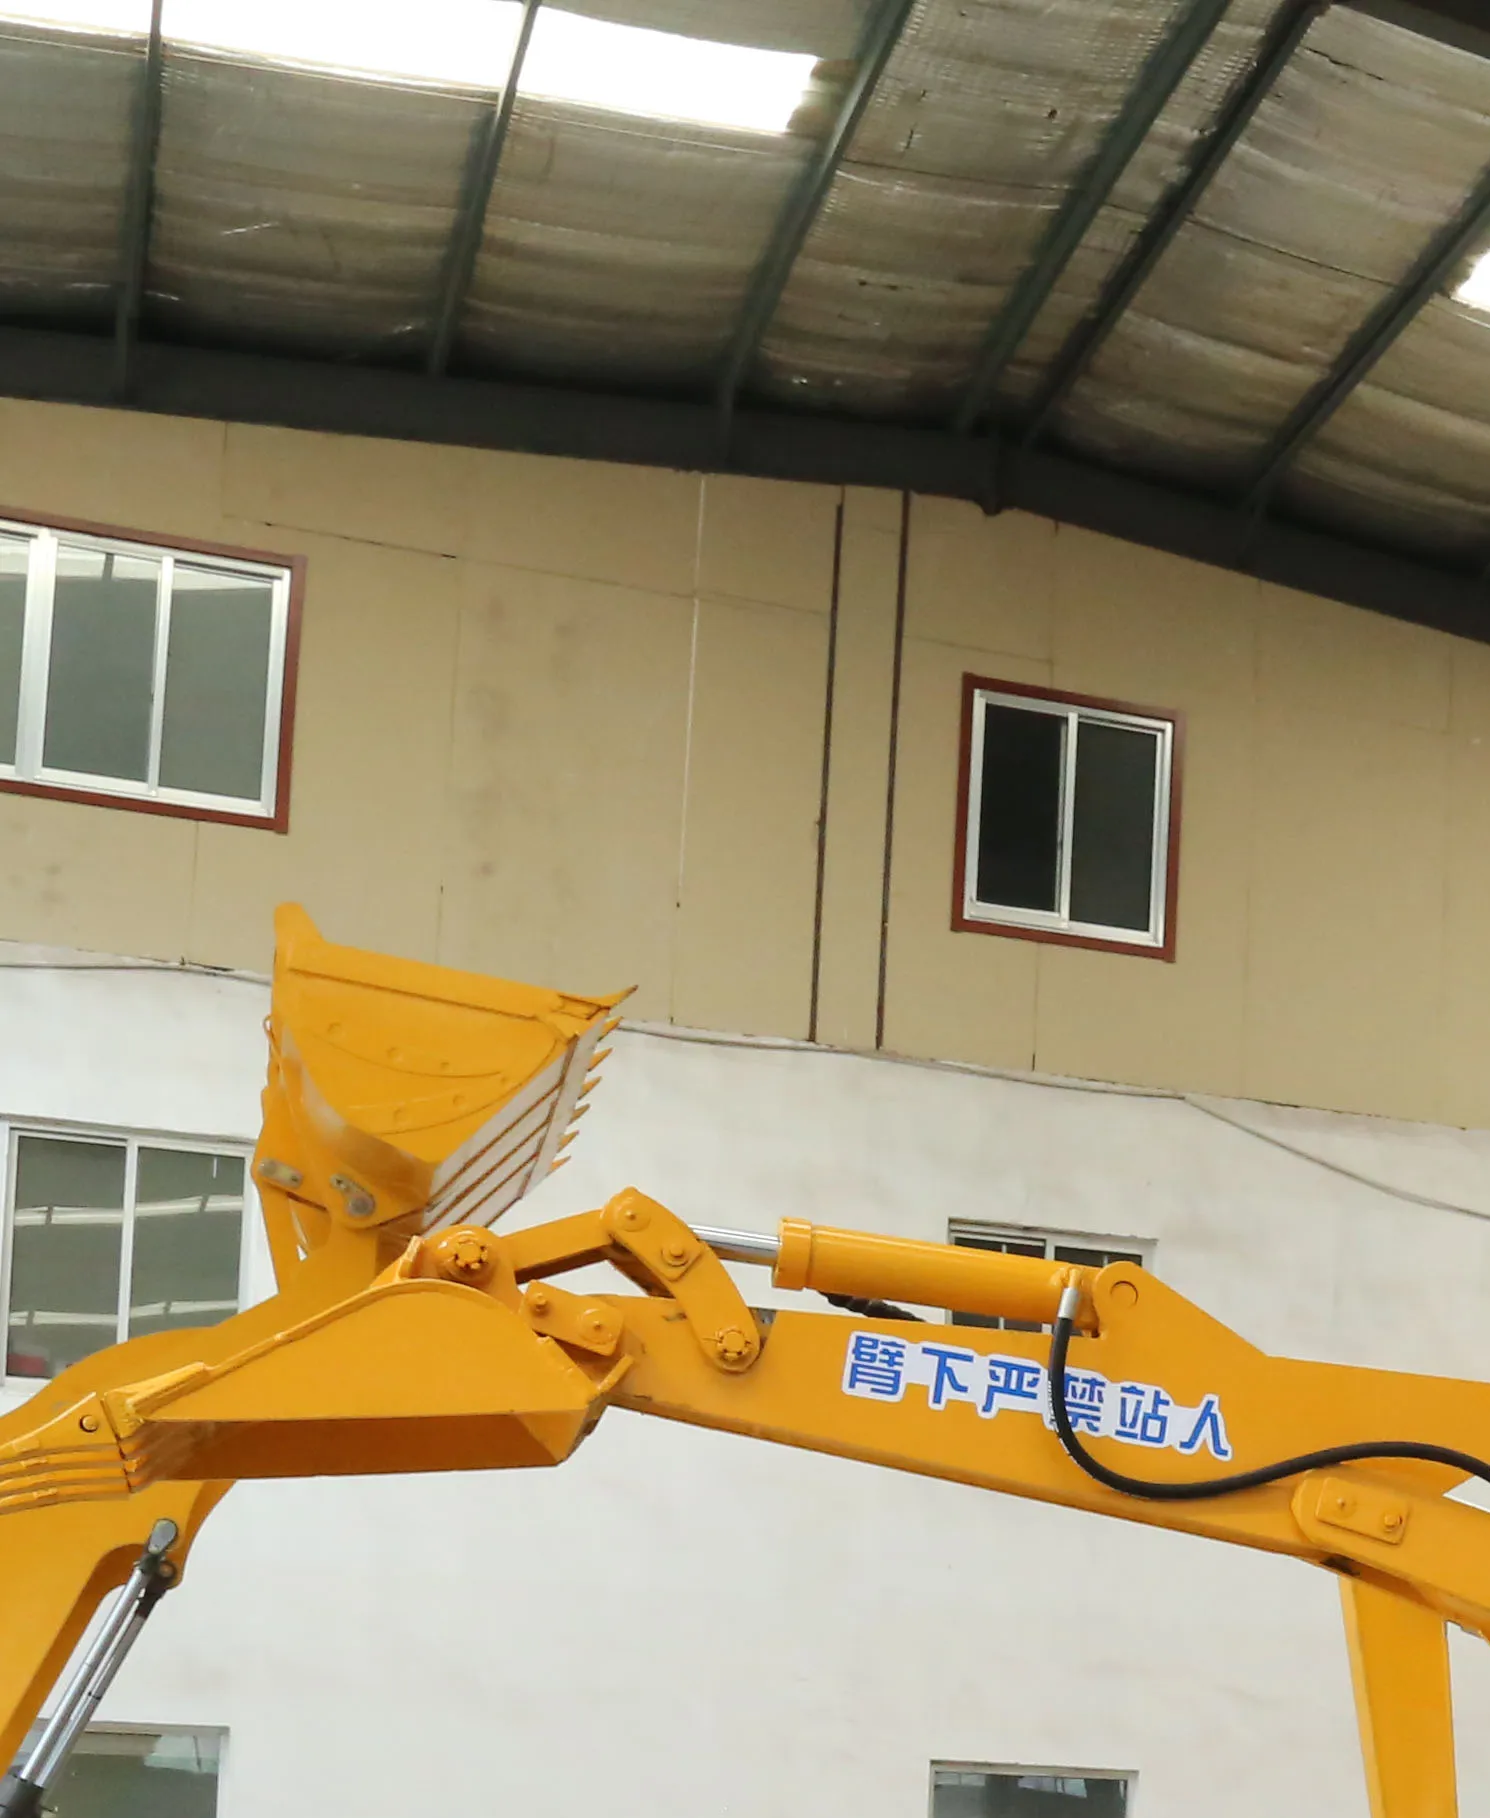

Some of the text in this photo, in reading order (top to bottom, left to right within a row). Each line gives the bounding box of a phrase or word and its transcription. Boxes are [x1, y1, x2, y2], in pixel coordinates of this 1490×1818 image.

[848, 1334, 1229, 1457] 臂下严禁站人
